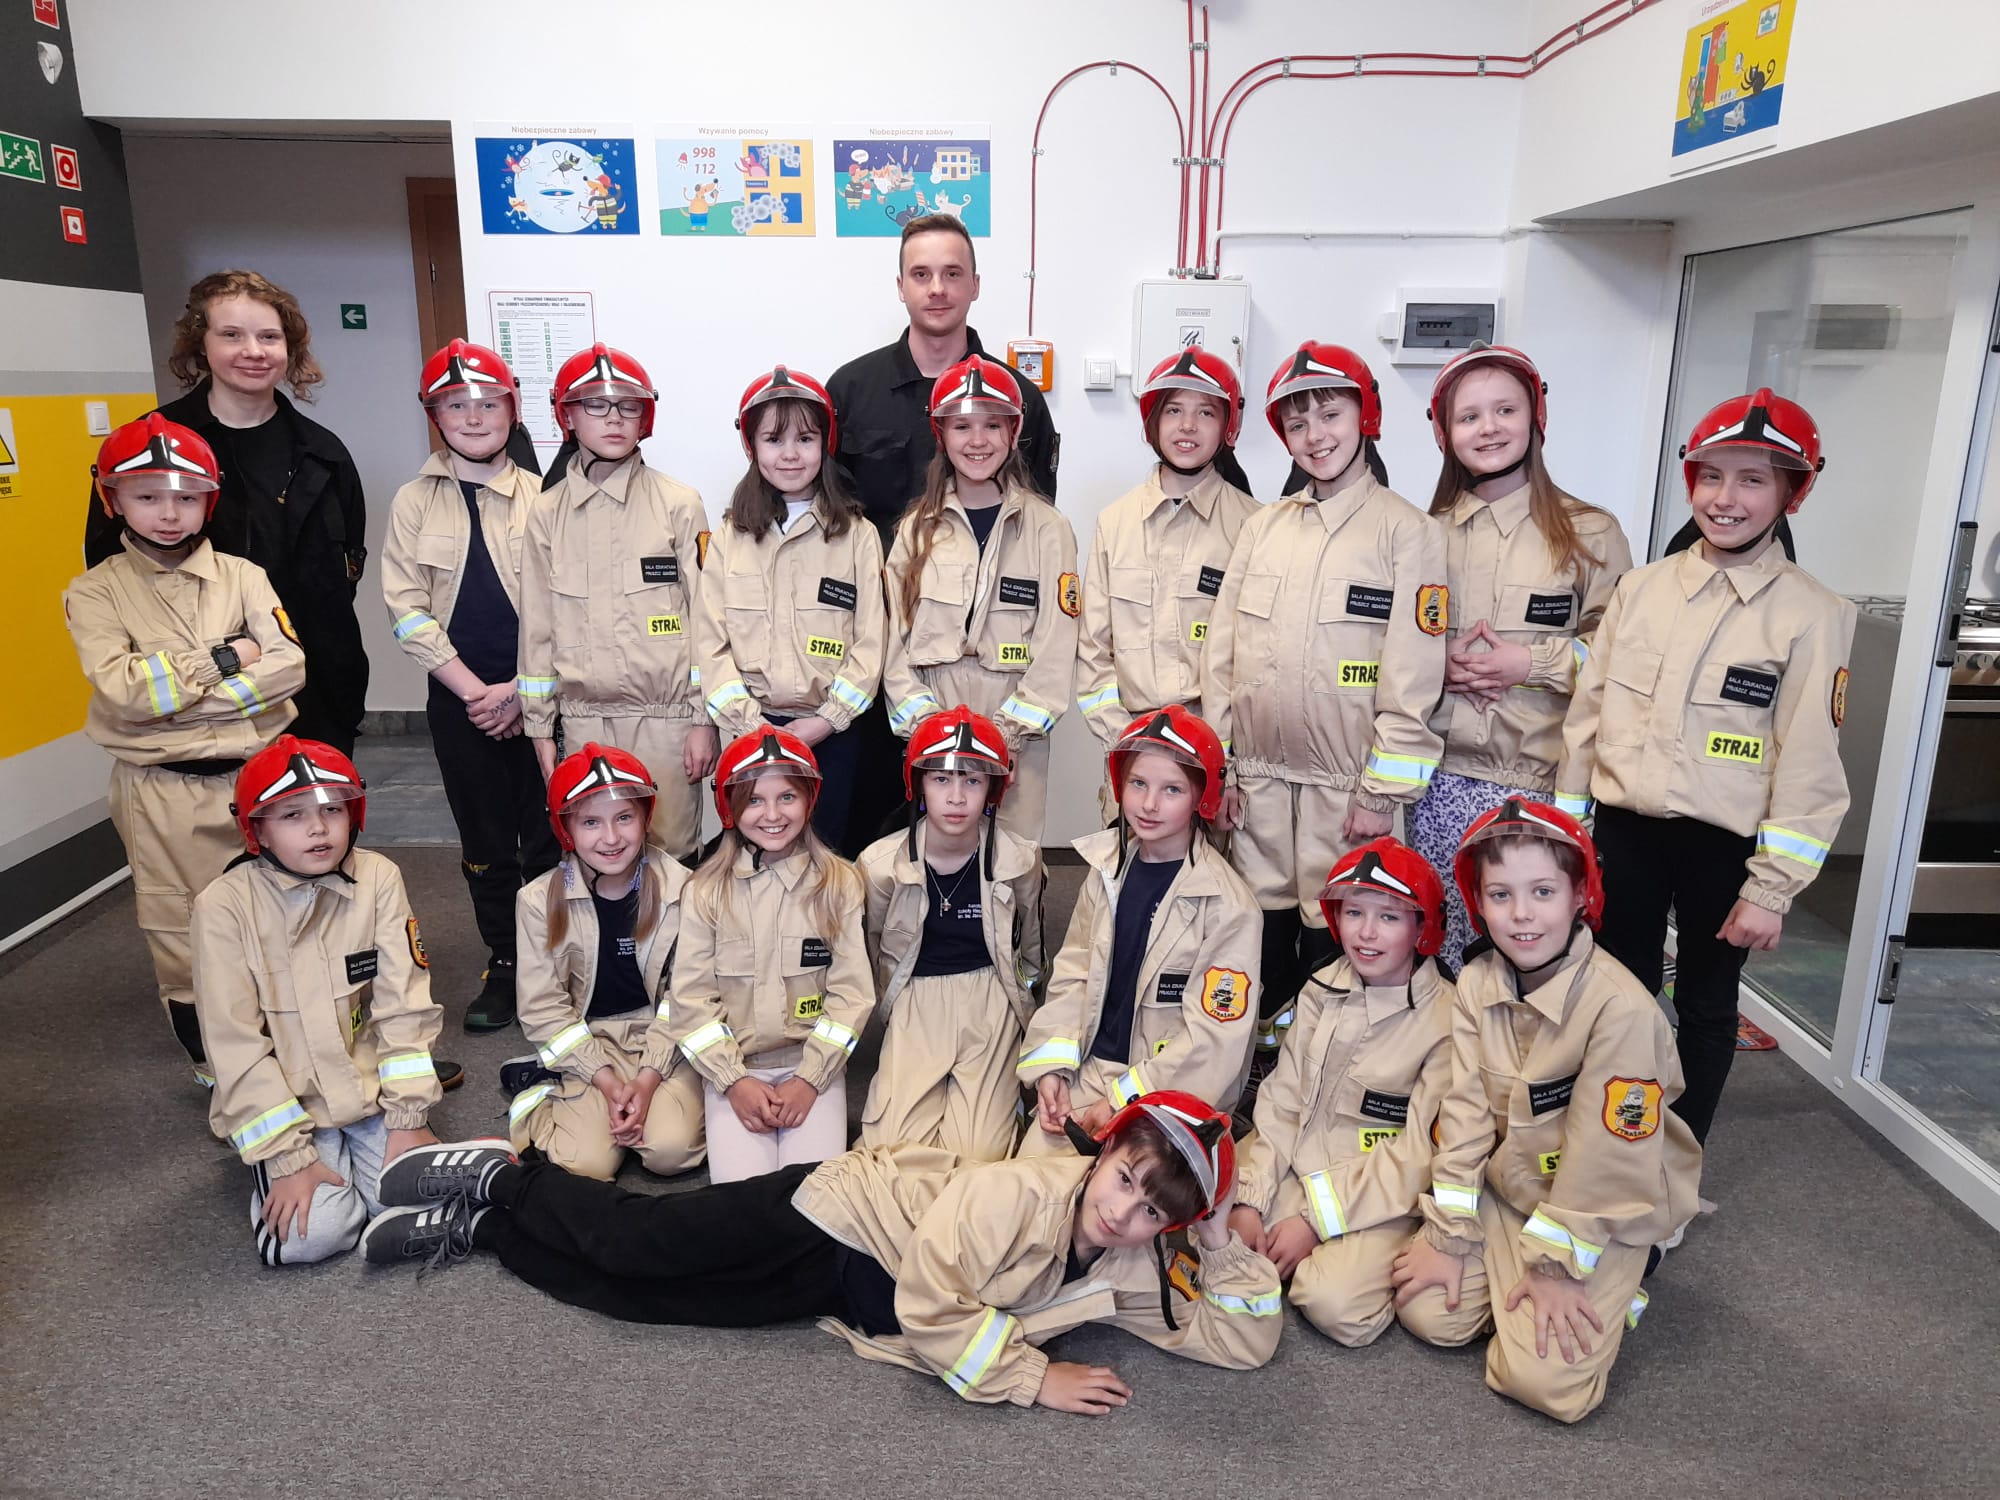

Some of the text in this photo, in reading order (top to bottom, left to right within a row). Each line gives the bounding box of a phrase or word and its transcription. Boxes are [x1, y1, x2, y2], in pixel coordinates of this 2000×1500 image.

[512, 126, 597, 135] Niebezpieczne zabawy
[698, 127, 736, 136] Wzywanie
[869, 128, 954, 136] Niebezpieczne zabawy
[693, 147, 716, 158] 998
[695, 163, 715, 174] 112
[1002, 647, 1028, 660] STRA
[799, 996, 822, 1014] STRA
